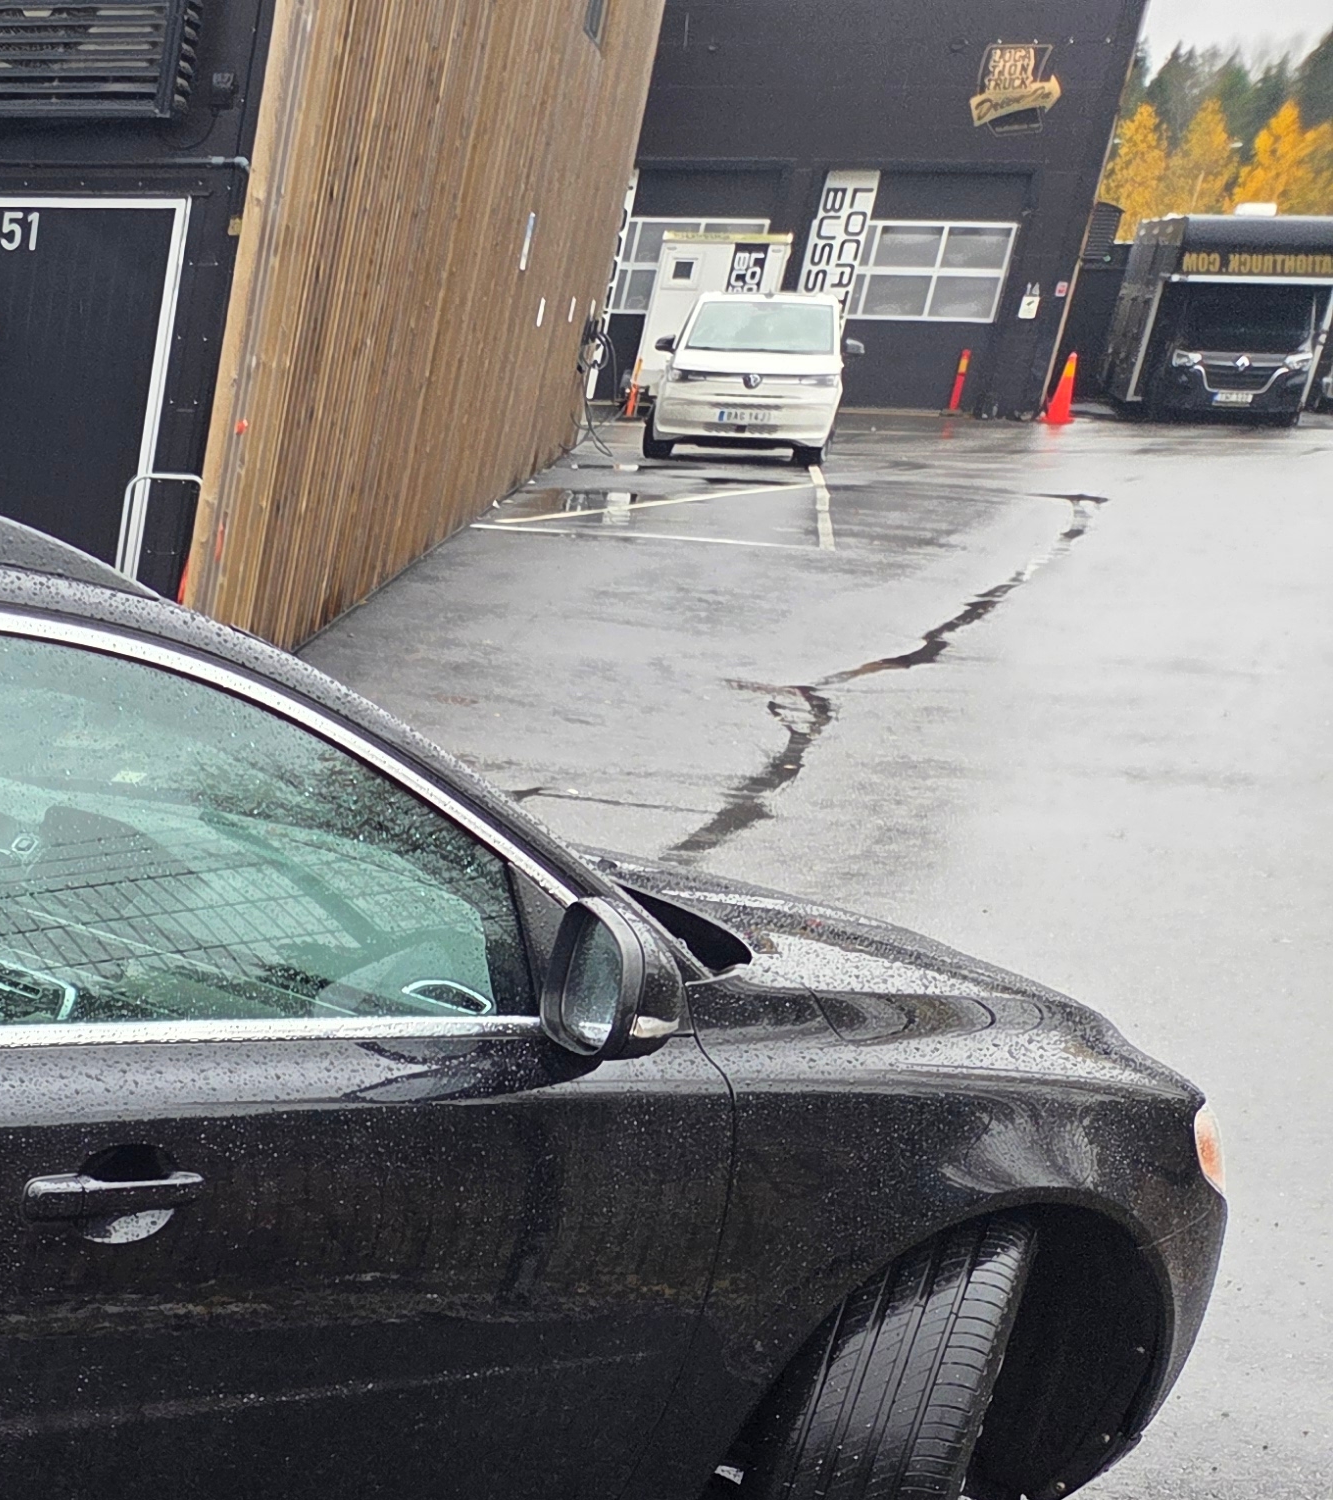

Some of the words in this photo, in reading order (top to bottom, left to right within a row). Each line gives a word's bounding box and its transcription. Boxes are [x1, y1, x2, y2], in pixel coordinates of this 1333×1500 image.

[986, 77, 1029, 90] TRUCK
[0, 211, 39, 250] 51
[804, 187, 847, 292] BUSS
[831, 187, 875, 323] LOCAT
